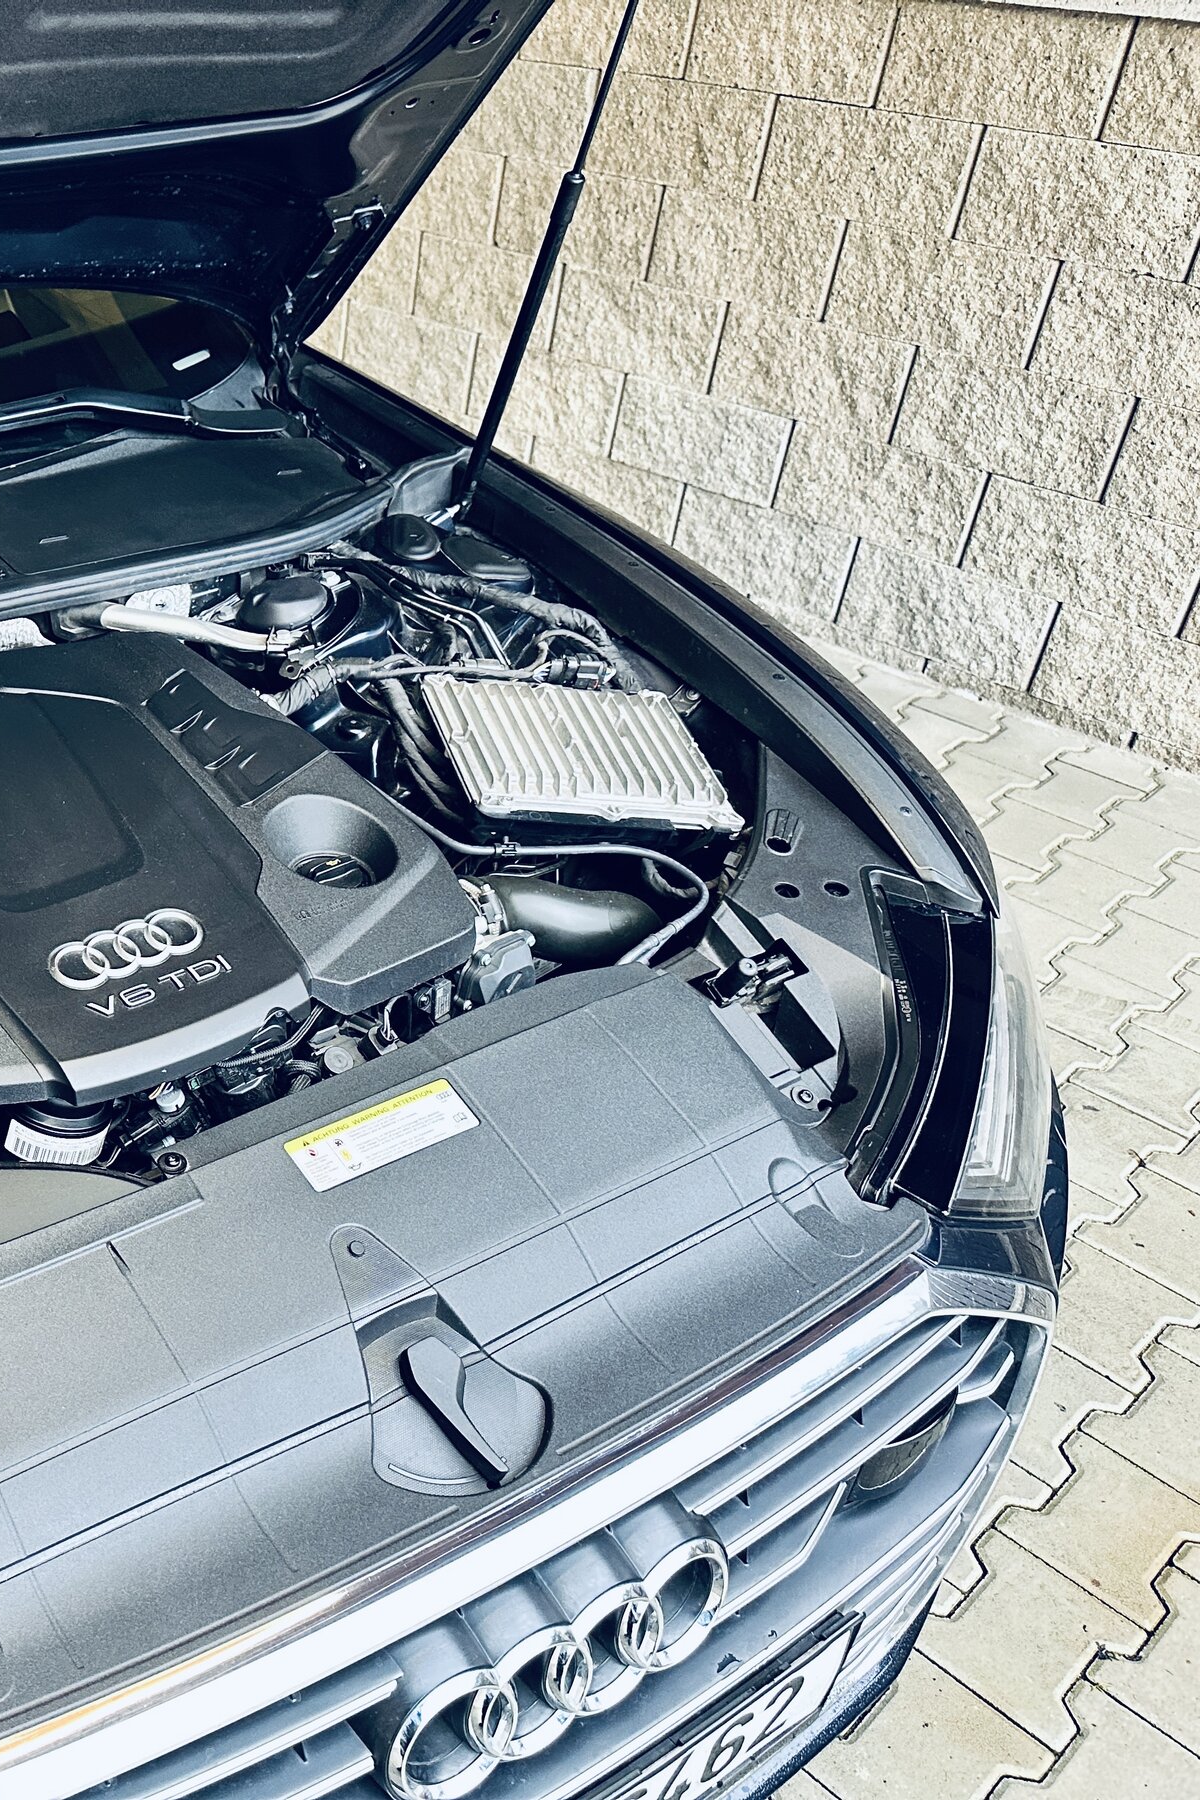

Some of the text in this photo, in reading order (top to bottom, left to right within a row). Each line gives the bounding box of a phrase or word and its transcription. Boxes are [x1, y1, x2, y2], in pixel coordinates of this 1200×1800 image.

[85, 954, 233, 1018] V6 TDI
[312, 1089, 433, 1142] ACHTUNG WARNING ATTENTION
